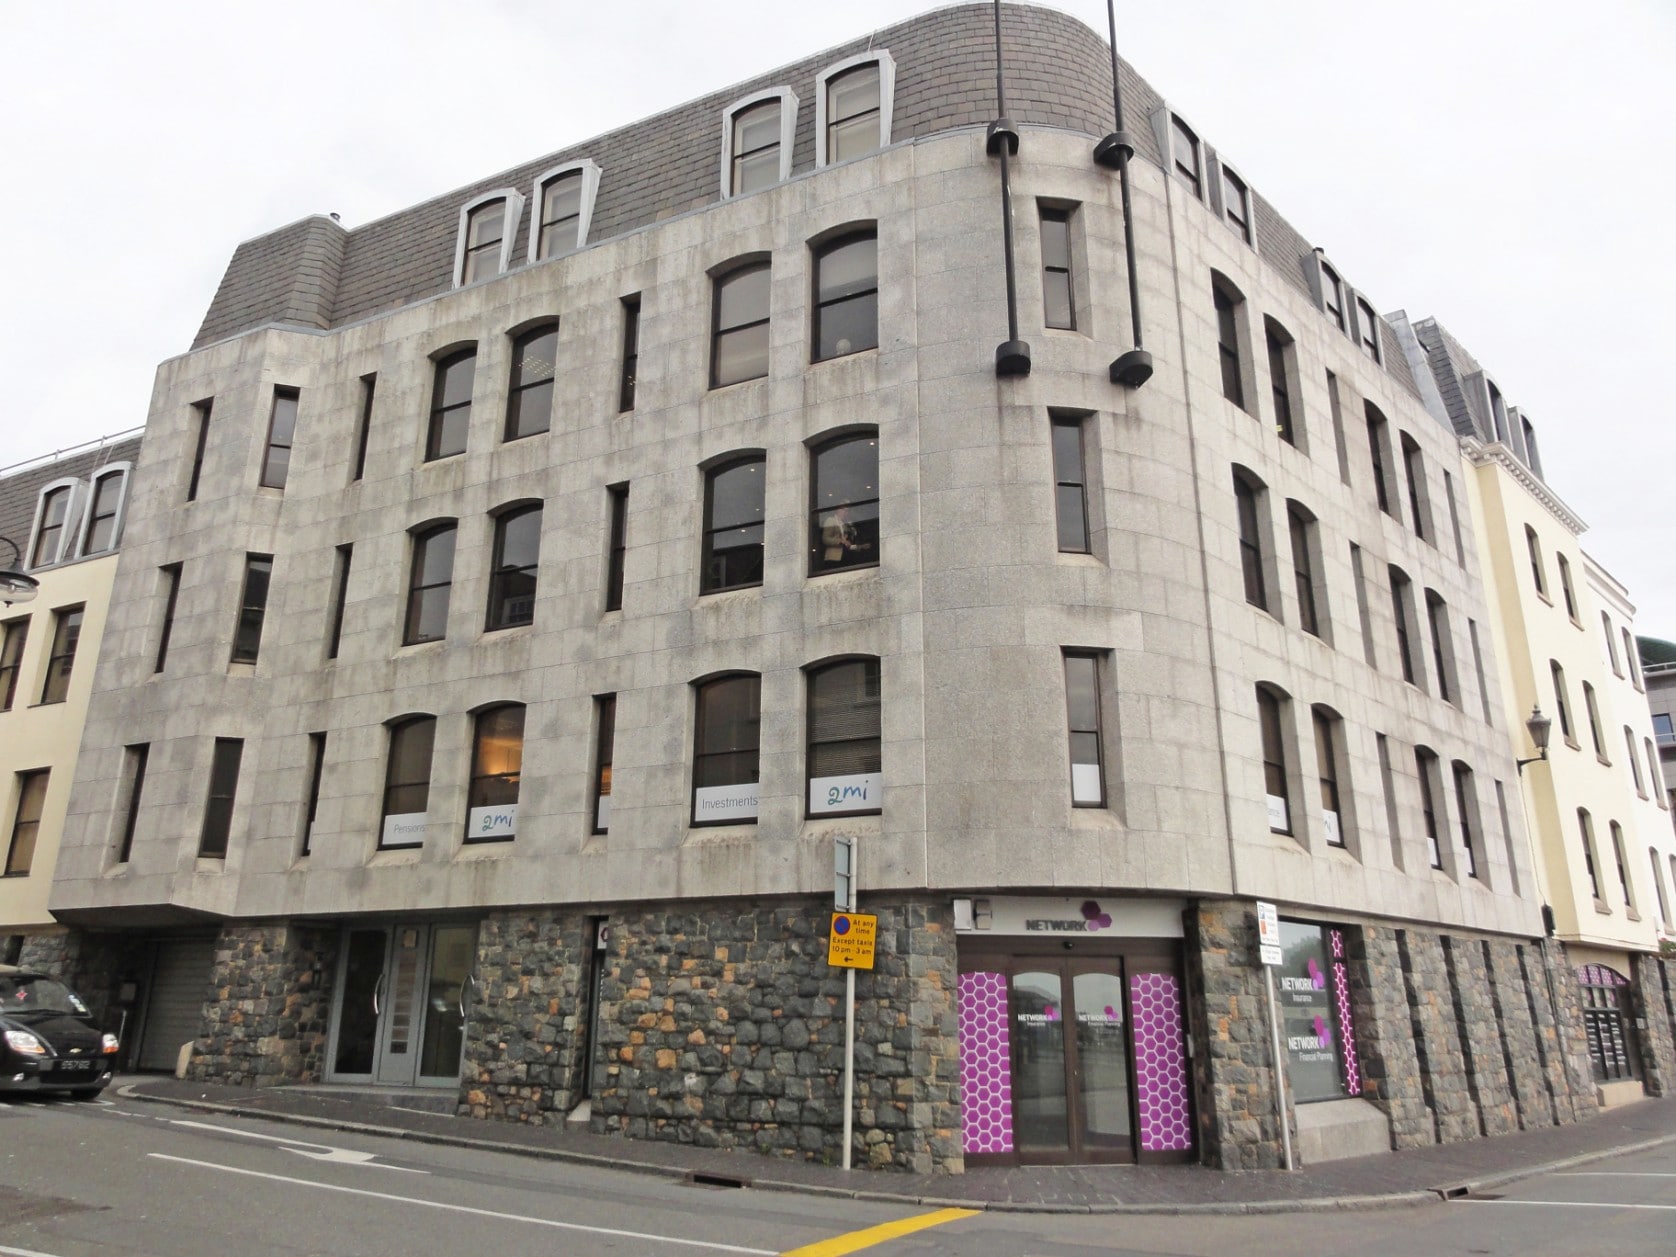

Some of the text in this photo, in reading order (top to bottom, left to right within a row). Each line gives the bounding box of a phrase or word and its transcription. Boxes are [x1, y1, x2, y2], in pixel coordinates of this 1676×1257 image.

[702, 796, 759, 810] Investments
[1026, 919, 1088, 931] NETWORK
[832, 936, 855, 945] Except
[1281, 976, 1313, 991] NETWORK
[1017, 1013, 1047, 1021] NETWORK
[1288, 1035, 1320, 1050] NETWORK
